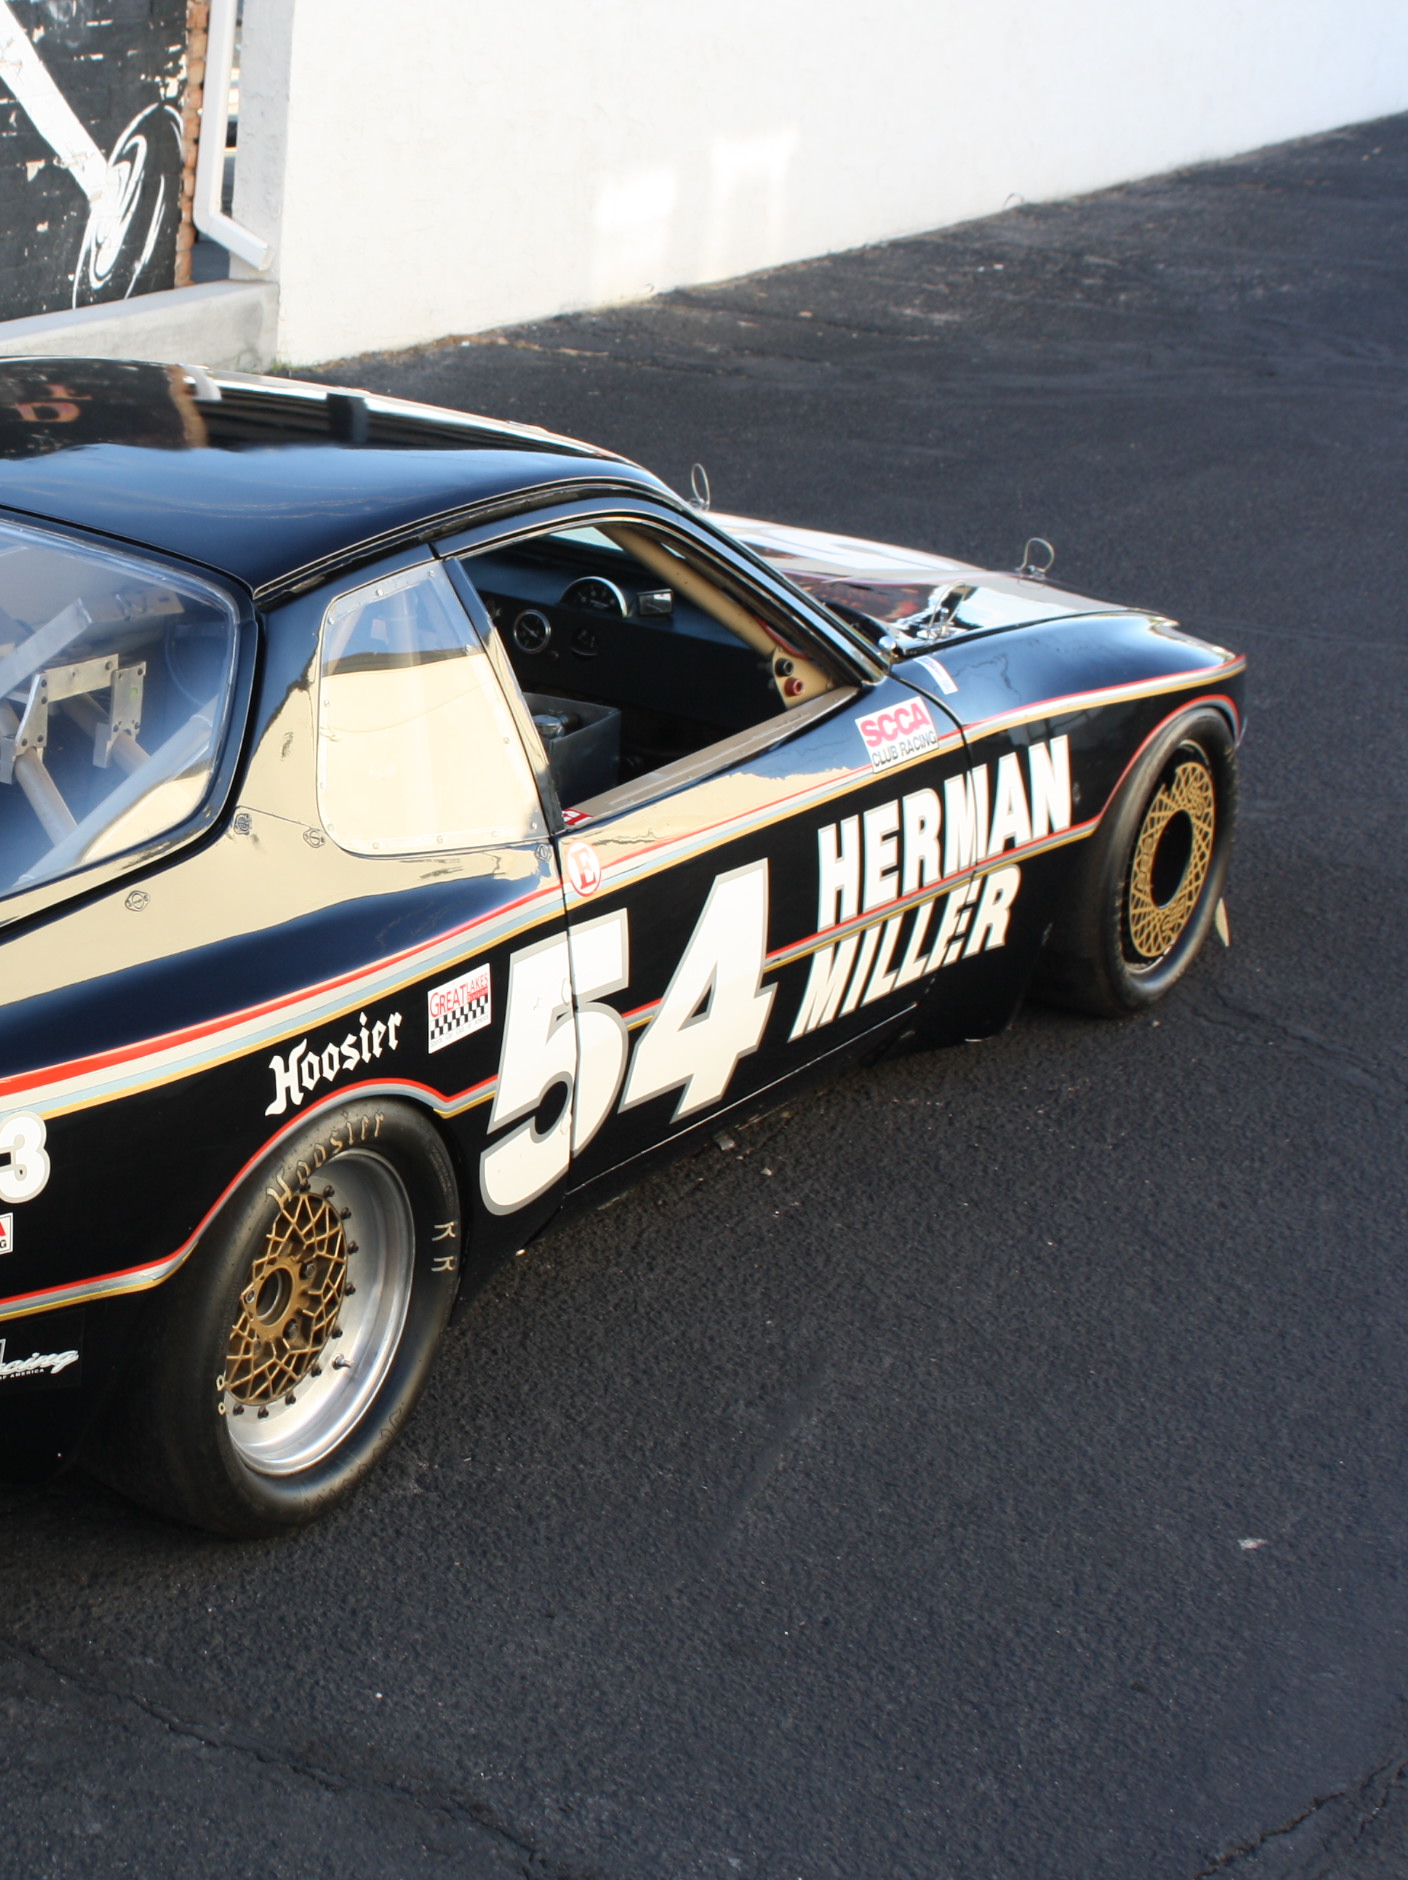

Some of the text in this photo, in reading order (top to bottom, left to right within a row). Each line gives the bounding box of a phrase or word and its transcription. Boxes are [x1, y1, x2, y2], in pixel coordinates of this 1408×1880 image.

[860, 703, 930, 747] SCCA
[872, 731, 937, 767] CLUB RACING
[817, 734, 1072, 933] HERMAN
[787, 863, 1022, 1043] MILLER
[429, 984, 467, 1018] GREAT
[479, 857, 779, 1216] 54
[264, 1011, 403, 1117] Hoosier
[9, 1368, 45, 1379] AMERICA
